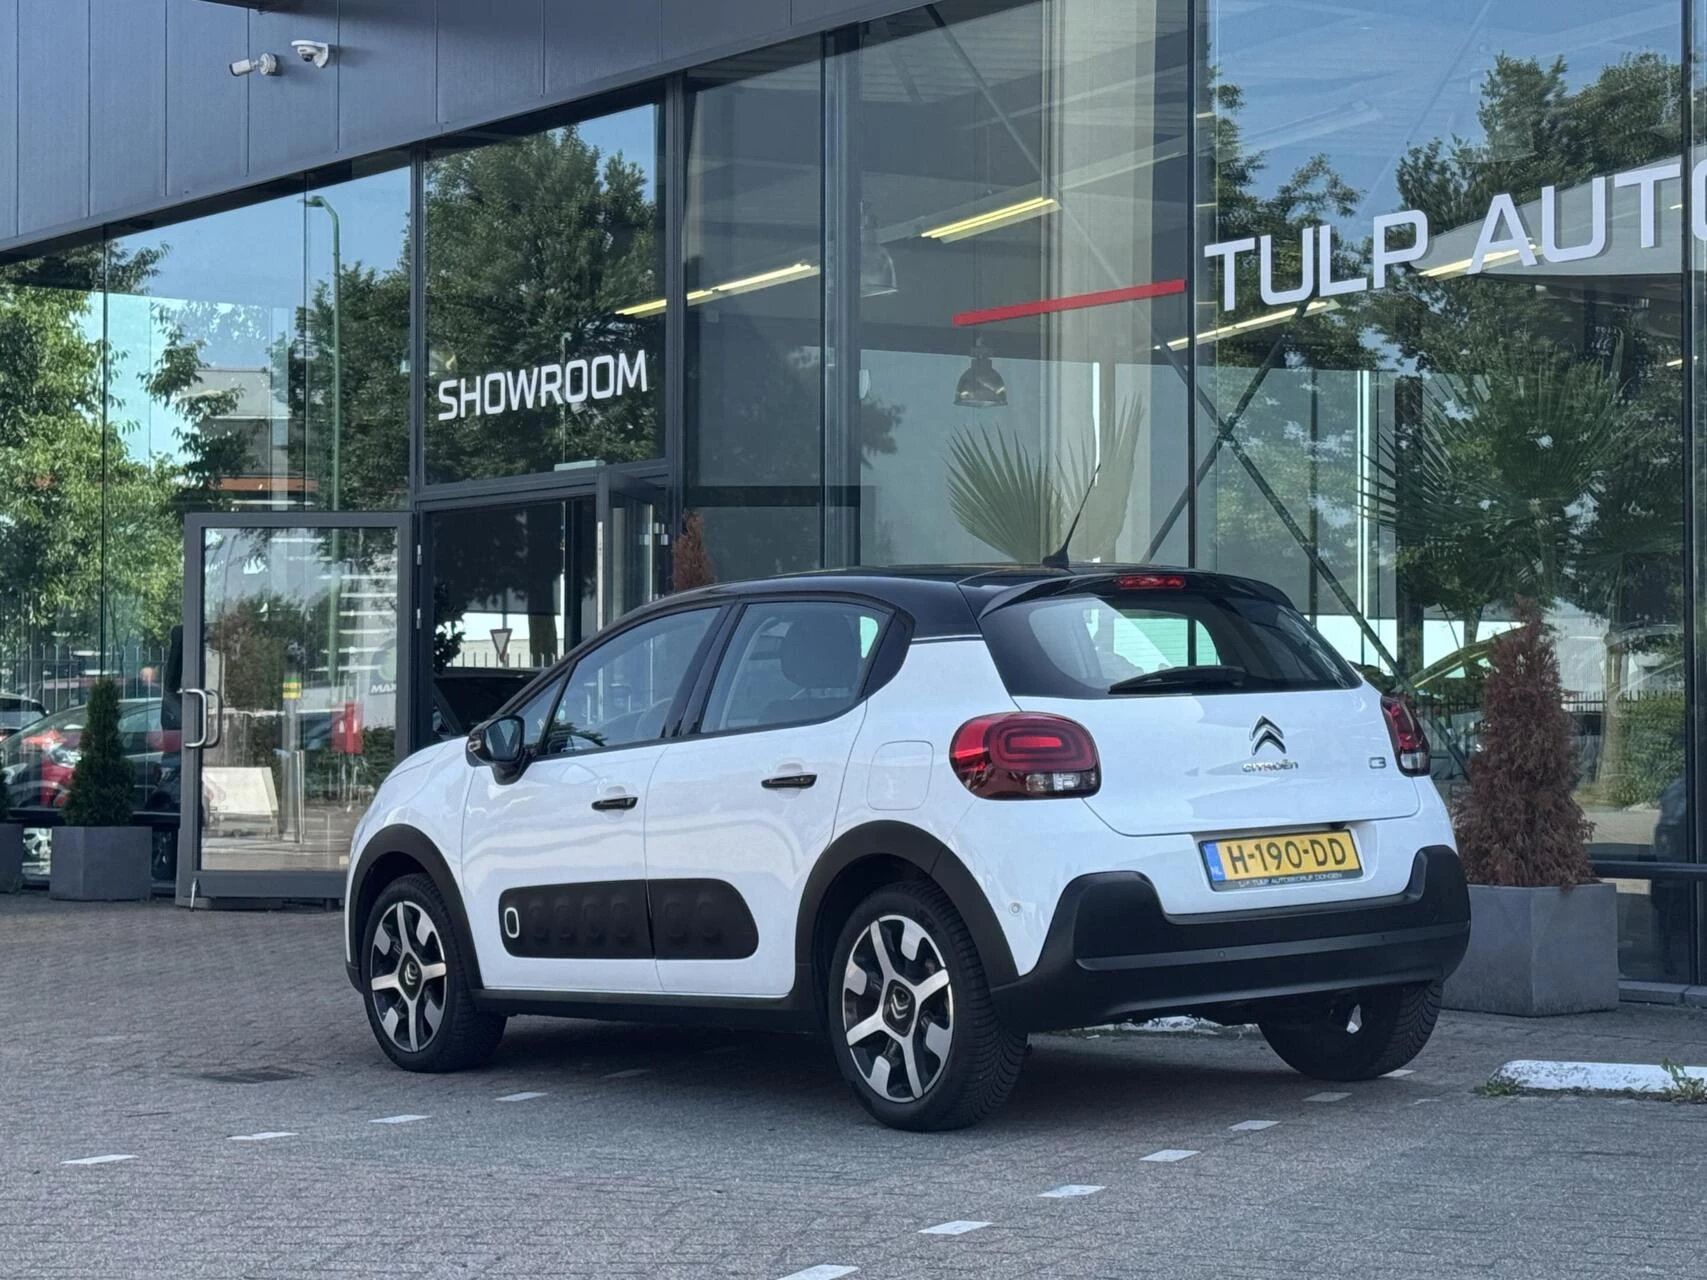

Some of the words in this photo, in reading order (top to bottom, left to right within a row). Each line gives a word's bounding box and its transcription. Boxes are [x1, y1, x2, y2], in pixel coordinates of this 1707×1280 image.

[1204, 209, 1429, 311] TULP
[1466, 159, 1707, 275] AUT
[438, 349, 648, 421] SHOWROOM
[1226, 838, 1347, 874] H-190-DD
